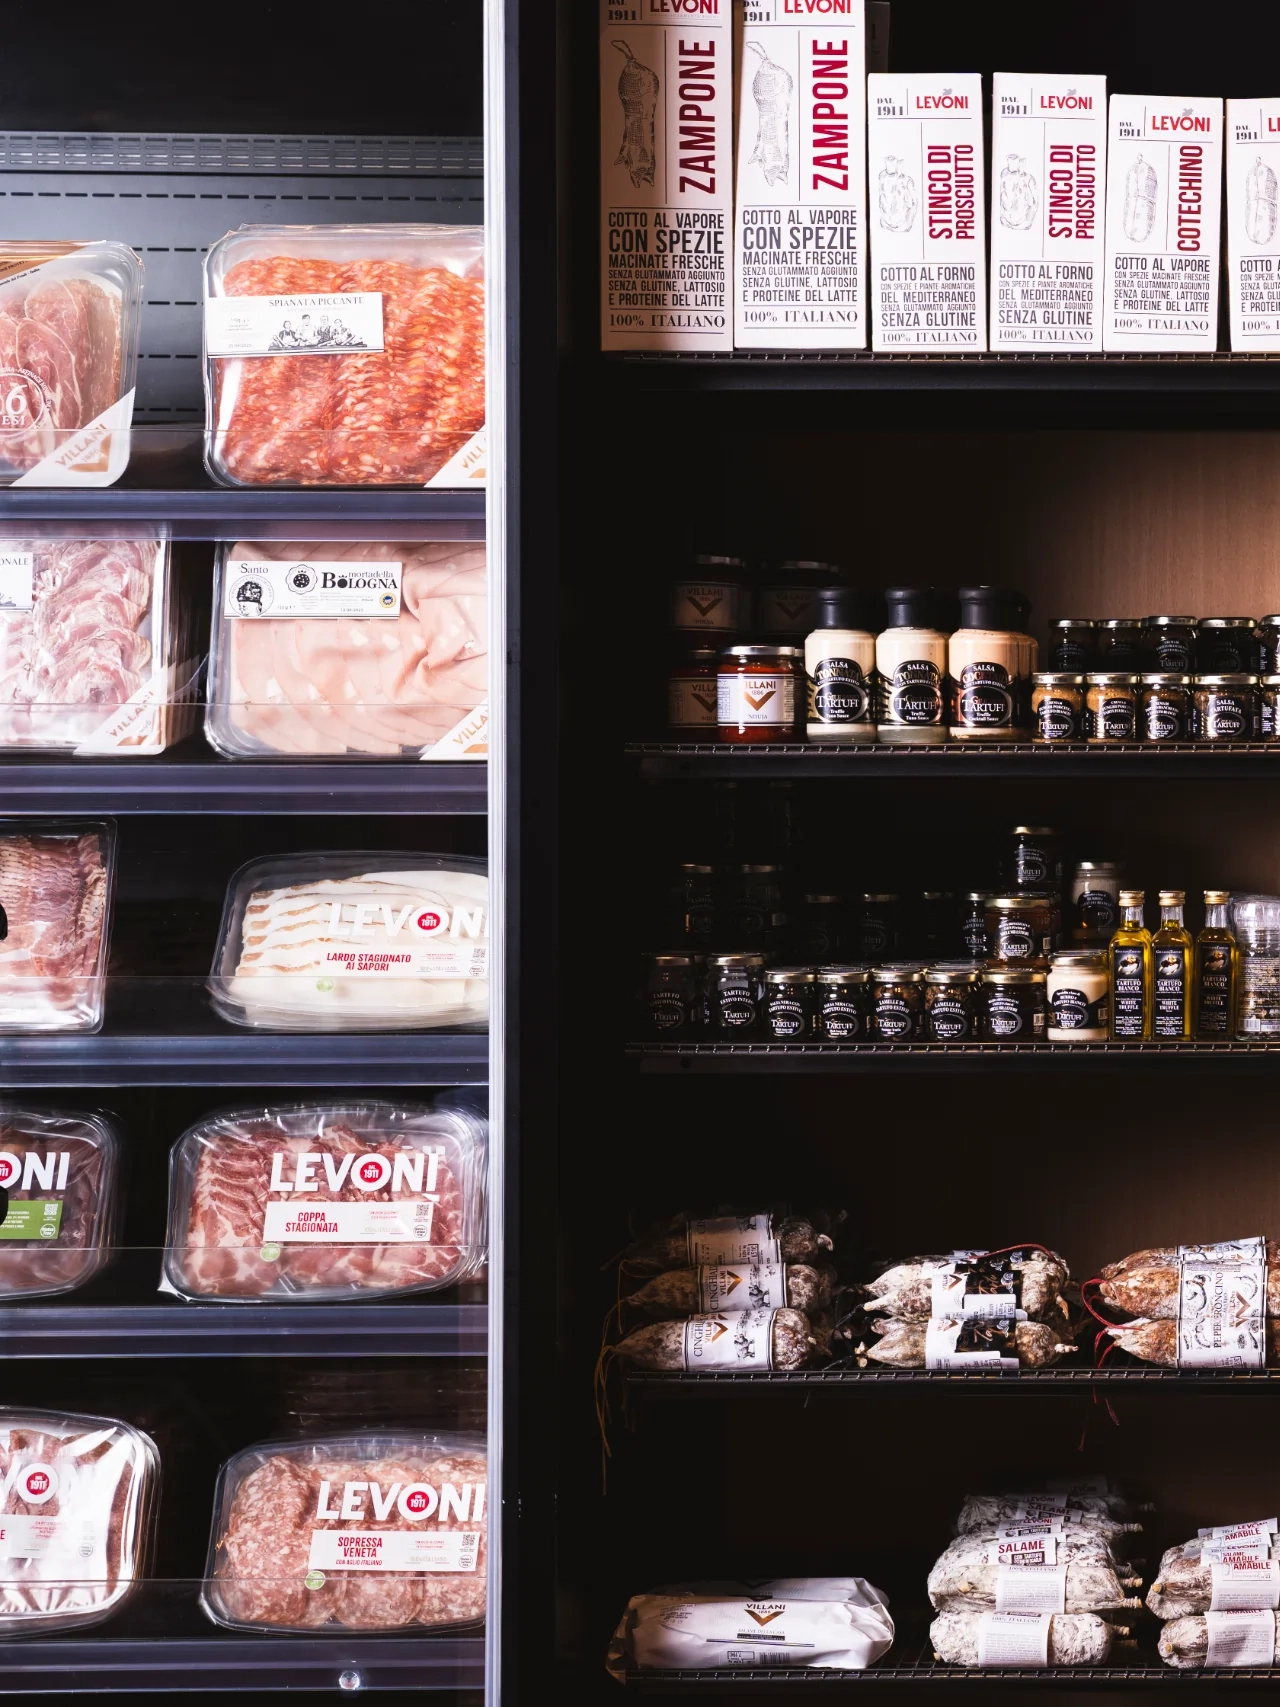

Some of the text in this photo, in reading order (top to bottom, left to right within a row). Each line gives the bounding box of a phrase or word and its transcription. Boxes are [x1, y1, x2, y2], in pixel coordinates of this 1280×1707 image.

[650, 0, 718, 13] LEVONI
[784, 0, 851, 13] LEVONI
[608, 10, 636, 20] 1911
[744, 11, 770, 21] 1911
[916, 96, 968, 109] LEVONI
[1040, 96, 1092, 109] LEVONI
[679, 39, 715, 194] ZAMPONE
[812, 39, 848, 190] ZAMPONE
[877, 106, 903, 115] 1911
[1152, 115, 1211, 132] LEVONI
[1119, 129, 1140, 137] 1911
[928, 145, 952, 239] STINCO DI
[955, 145, 974, 239] PROSCIUTTO
[1049, 145, 1073, 238] STINCO DI
[1076, 145, 1096, 239] PROSCIUTTO
[1177, 145, 1203, 251] COTECHINO
[608, 212, 724, 229] COTTO AL VAPORE
[609, 229, 724, 254] CON SPEZIE
[608, 255, 724, 270] MACINATE FRESCHE
[1115, 257, 1210, 272] COTTO AL VAPORE
[608, 270, 725, 280] SENZA GLUTAMMATO AGGIUNTO
[881, 267, 975, 281] COTTO AL FORNO
[608, 280, 725, 292] SENZA GLUTINE, LATTOSIO
[269, 297, 364, 307] SPIANATA PICCANTE
[609, 294, 724, 307] E PROTEINE DEL LATTE
[881, 291, 976, 303] DEL MEDITERRANEO
[610, 314, 725, 328] 100% ITALIANO
[881, 313, 976, 327] SENZA GLUTINE
[1114, 318, 1209, 331] 100% ITALIANO
[882, 332, 977, 342] 100% ITALIANO
[240, 563, 268, 574] Santo
[349, 570, 393, 578] mortadella
[742, 681, 776, 689] ILLANI
[816, 695, 859, 708] TARTUFI
[896, 697, 937, 710] TARTUFI
[962, 699, 1004, 712] TARTUFI
[421, 919, 437, 927] 1911
[327, 953, 355, 961] LARDO
[358, 954, 411, 963] STAGIONATO
[357, 963, 389, 971] SAPORI
[270, 1153, 439, 1192] LEVONI
[364, 1170, 379, 1178] 1911
[298, 1212, 325, 1222] COPPA
[285, 1223, 338, 1232] STAGIONATA
[316, 1481, 486, 1522] LEVONI
[410, 1499, 425, 1508] 1911
[1028, 1503, 1072, 1515] SALAME
[1225, 1528, 1261, 1540] AMABILE
[338, 1537, 382, 1548] SOPRESSA
[998, 1540, 1045, 1553] SALAME
[344, 1548, 377, 1558] VENETA
[1234, 1562, 1271, 1570] AMABILE
